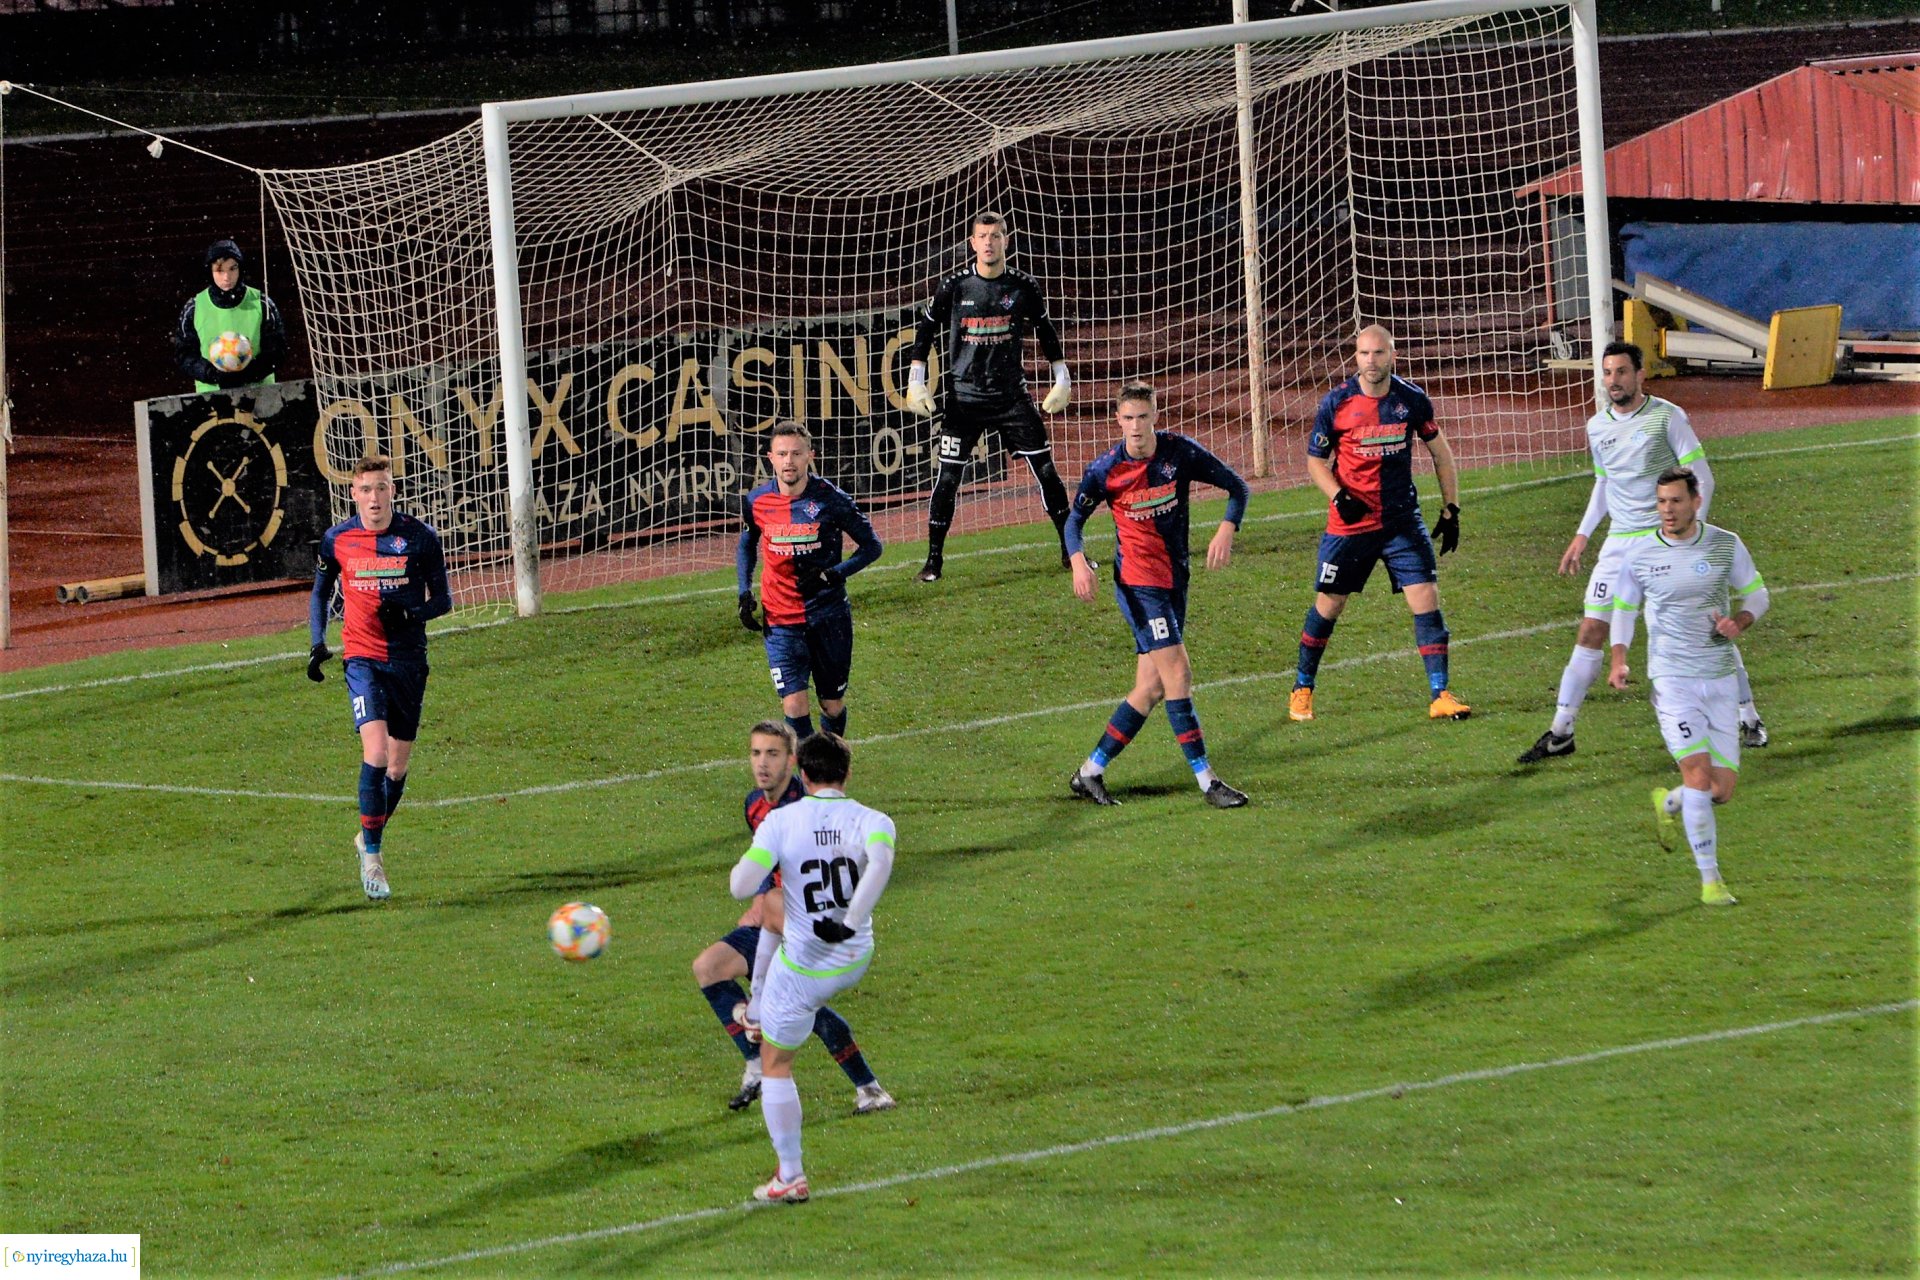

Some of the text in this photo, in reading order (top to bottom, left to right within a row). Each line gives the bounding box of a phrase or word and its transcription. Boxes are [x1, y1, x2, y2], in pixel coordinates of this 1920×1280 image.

[313, 329, 940, 485] ONYX CASINO
[941, 435, 961, 457] 95
[1319, 562, 1339, 584] 15
[1593, 582, 1608, 599] 19
[1148, 617, 1170, 641] 18
[770, 667, 786, 690] 2
[352, 695, 367, 720] 21
[1678, 721, 1692, 739] 5
[813, 826, 841, 846] TÓTH
[800, 856, 860, 914] 20
